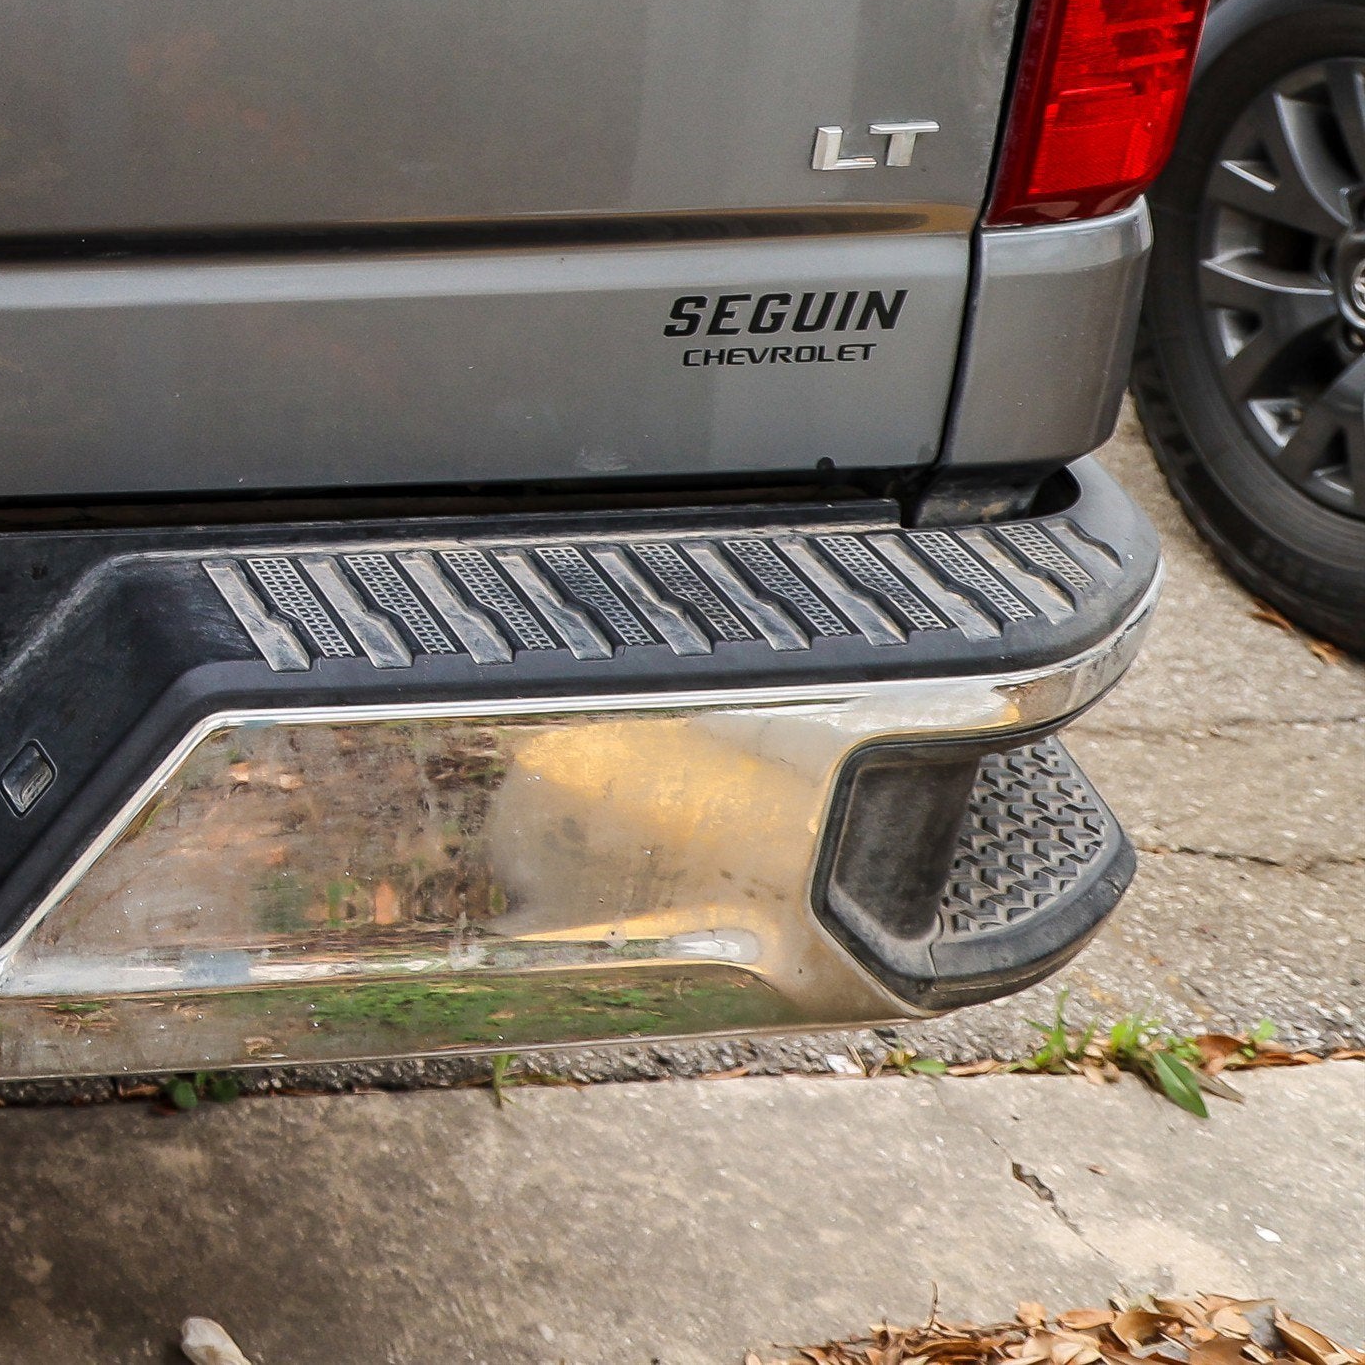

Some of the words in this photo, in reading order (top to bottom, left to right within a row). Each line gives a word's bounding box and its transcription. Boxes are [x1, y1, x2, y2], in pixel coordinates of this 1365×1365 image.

[811, 121, 940, 170] LT
[664, 289, 909, 337] SEGUIN
[681, 343, 877, 367] CHEVROLET
